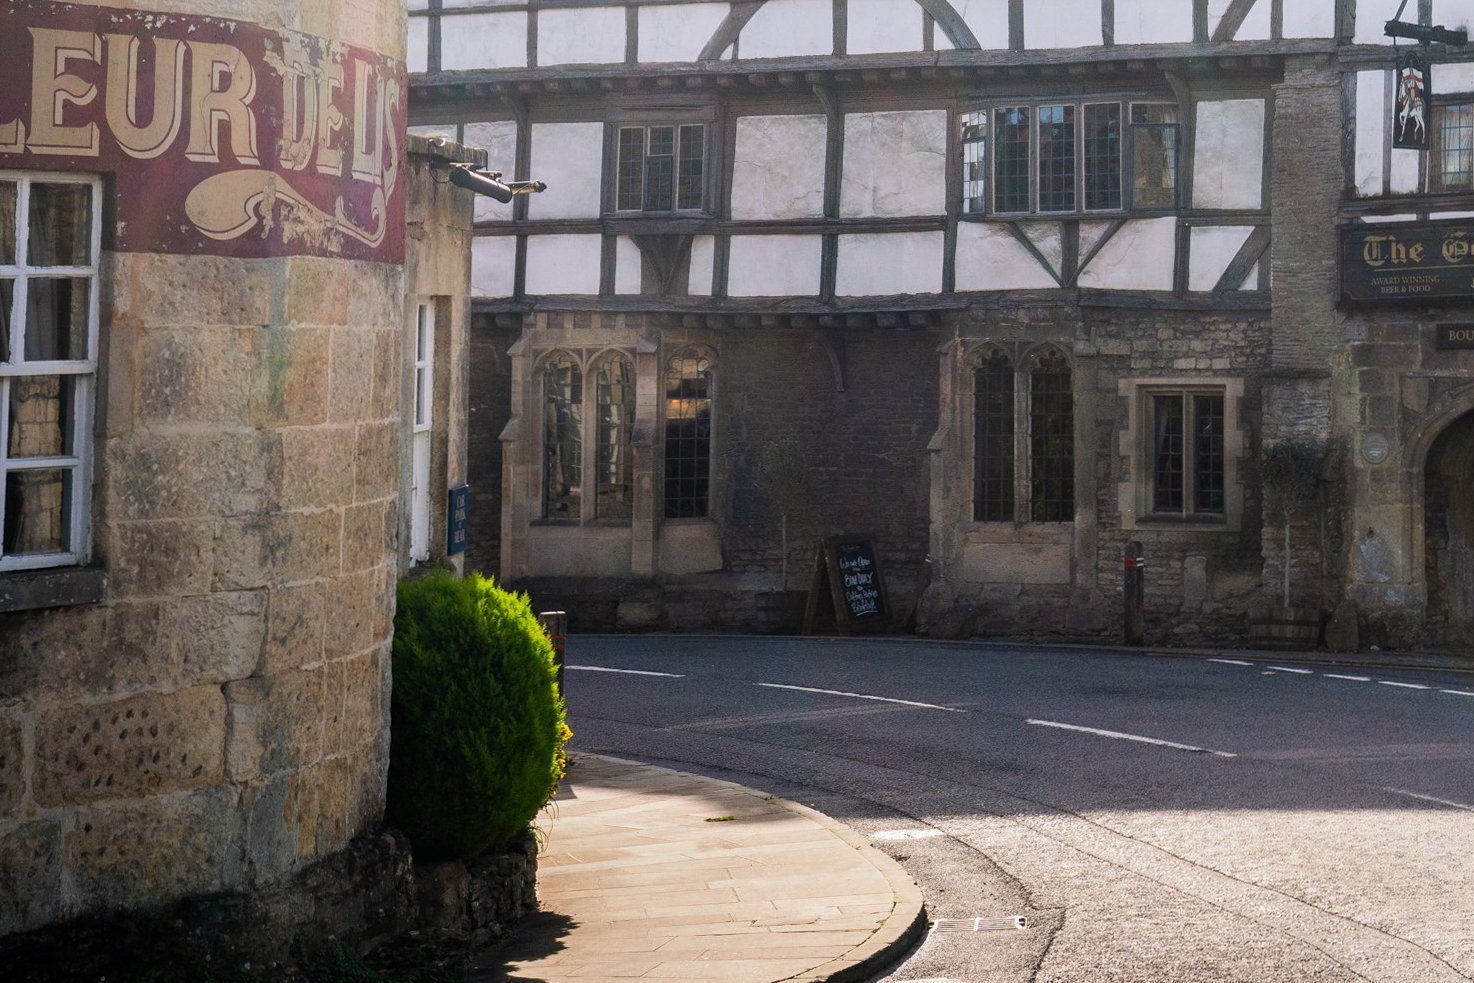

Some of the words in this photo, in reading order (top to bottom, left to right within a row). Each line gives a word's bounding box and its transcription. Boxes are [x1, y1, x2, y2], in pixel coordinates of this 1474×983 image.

[0, 26, 260, 166] EUR
[1363, 235, 1425, 267] The
[1371, 276, 1401, 286] AWARD
[1401, 274, 1441, 285] WINNING
[1381, 285, 1400, 294] BEER
[1401, 285, 1408, 293] &
[1408, 284, 1431, 293] FOOD
